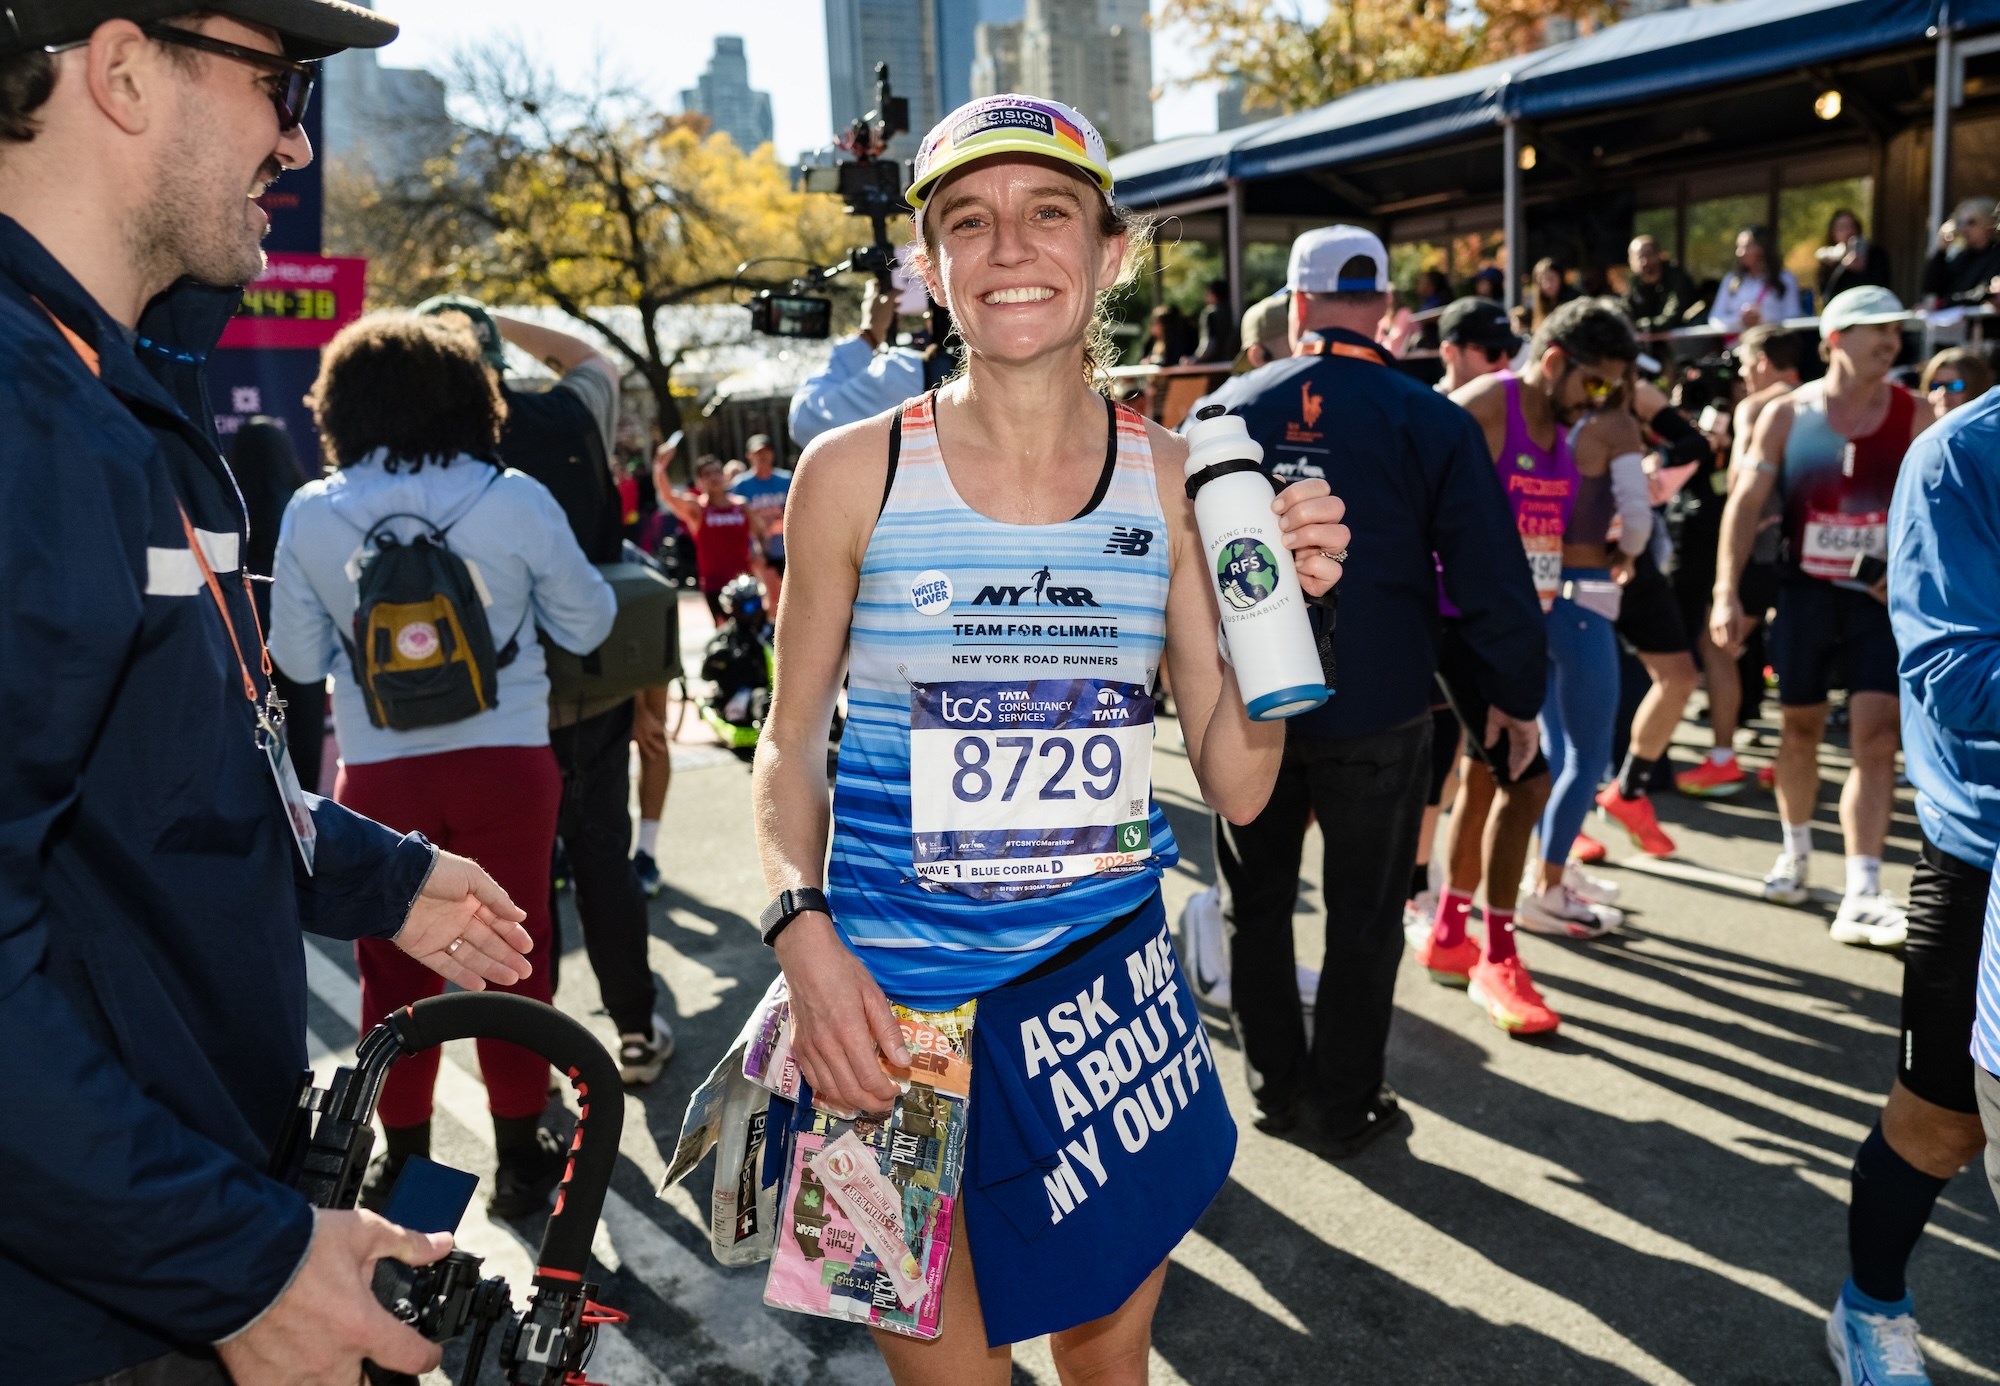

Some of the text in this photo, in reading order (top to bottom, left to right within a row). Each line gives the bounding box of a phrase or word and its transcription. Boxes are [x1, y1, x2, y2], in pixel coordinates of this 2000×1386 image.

[1103, 526, 1154, 557] NB
[1210, 527, 1263, 551] RACING FOR
[1229, 556, 1261, 576] RFS
[911, 580, 948, 599] WATER
[914, 590, 949, 608] LOVER
[1224, 596, 1289, 623] SUSTAINABILITY
[952, 624, 1118, 638] TEAM FOR CLIMATE
[952, 655, 1118, 666] NEW YORK ROAD RUNNERS
[997, 691, 1031, 701] TATA
[941, 690, 993, 723] tcs
[998, 701, 1073, 712] CONSULTANCY
[1092, 707, 1130, 721] TATA
[998, 712, 1046, 723] SERVICES
[951, 734, 1122, 803] 8729
[1005, 839, 1075, 848] #TCSNYCMarathon
[917, 860, 1064, 878] WAVE 1 BLUE CORRAL D
[1093, 854, 1135, 871] 2025
[1020, 923, 1176, 1079] ASK ME
[911, 1052, 950, 1077] ER
[1049, 980, 1188, 1133] ABOUT
[782, 1060, 795, 1086] APPLE
[1043, 1023, 1213, 1225] MY OUTFI
[890, 1129, 919, 1165] PICKY
[742, 1114, 767, 1206] essentia
[861, 1174, 890, 1211] FRUIT BAR
[846, 1185, 889, 1225] STRAWBERRY
[795, 1223, 822, 1239] BEAR
[827, 1227, 856, 1242] Rolls
[890, 1223, 905, 1241] PPLE
[826, 1237, 854, 1254] Fruit
[879, 1234, 895, 1254] TRADER
[872, 1273, 898, 1310] PICKY
